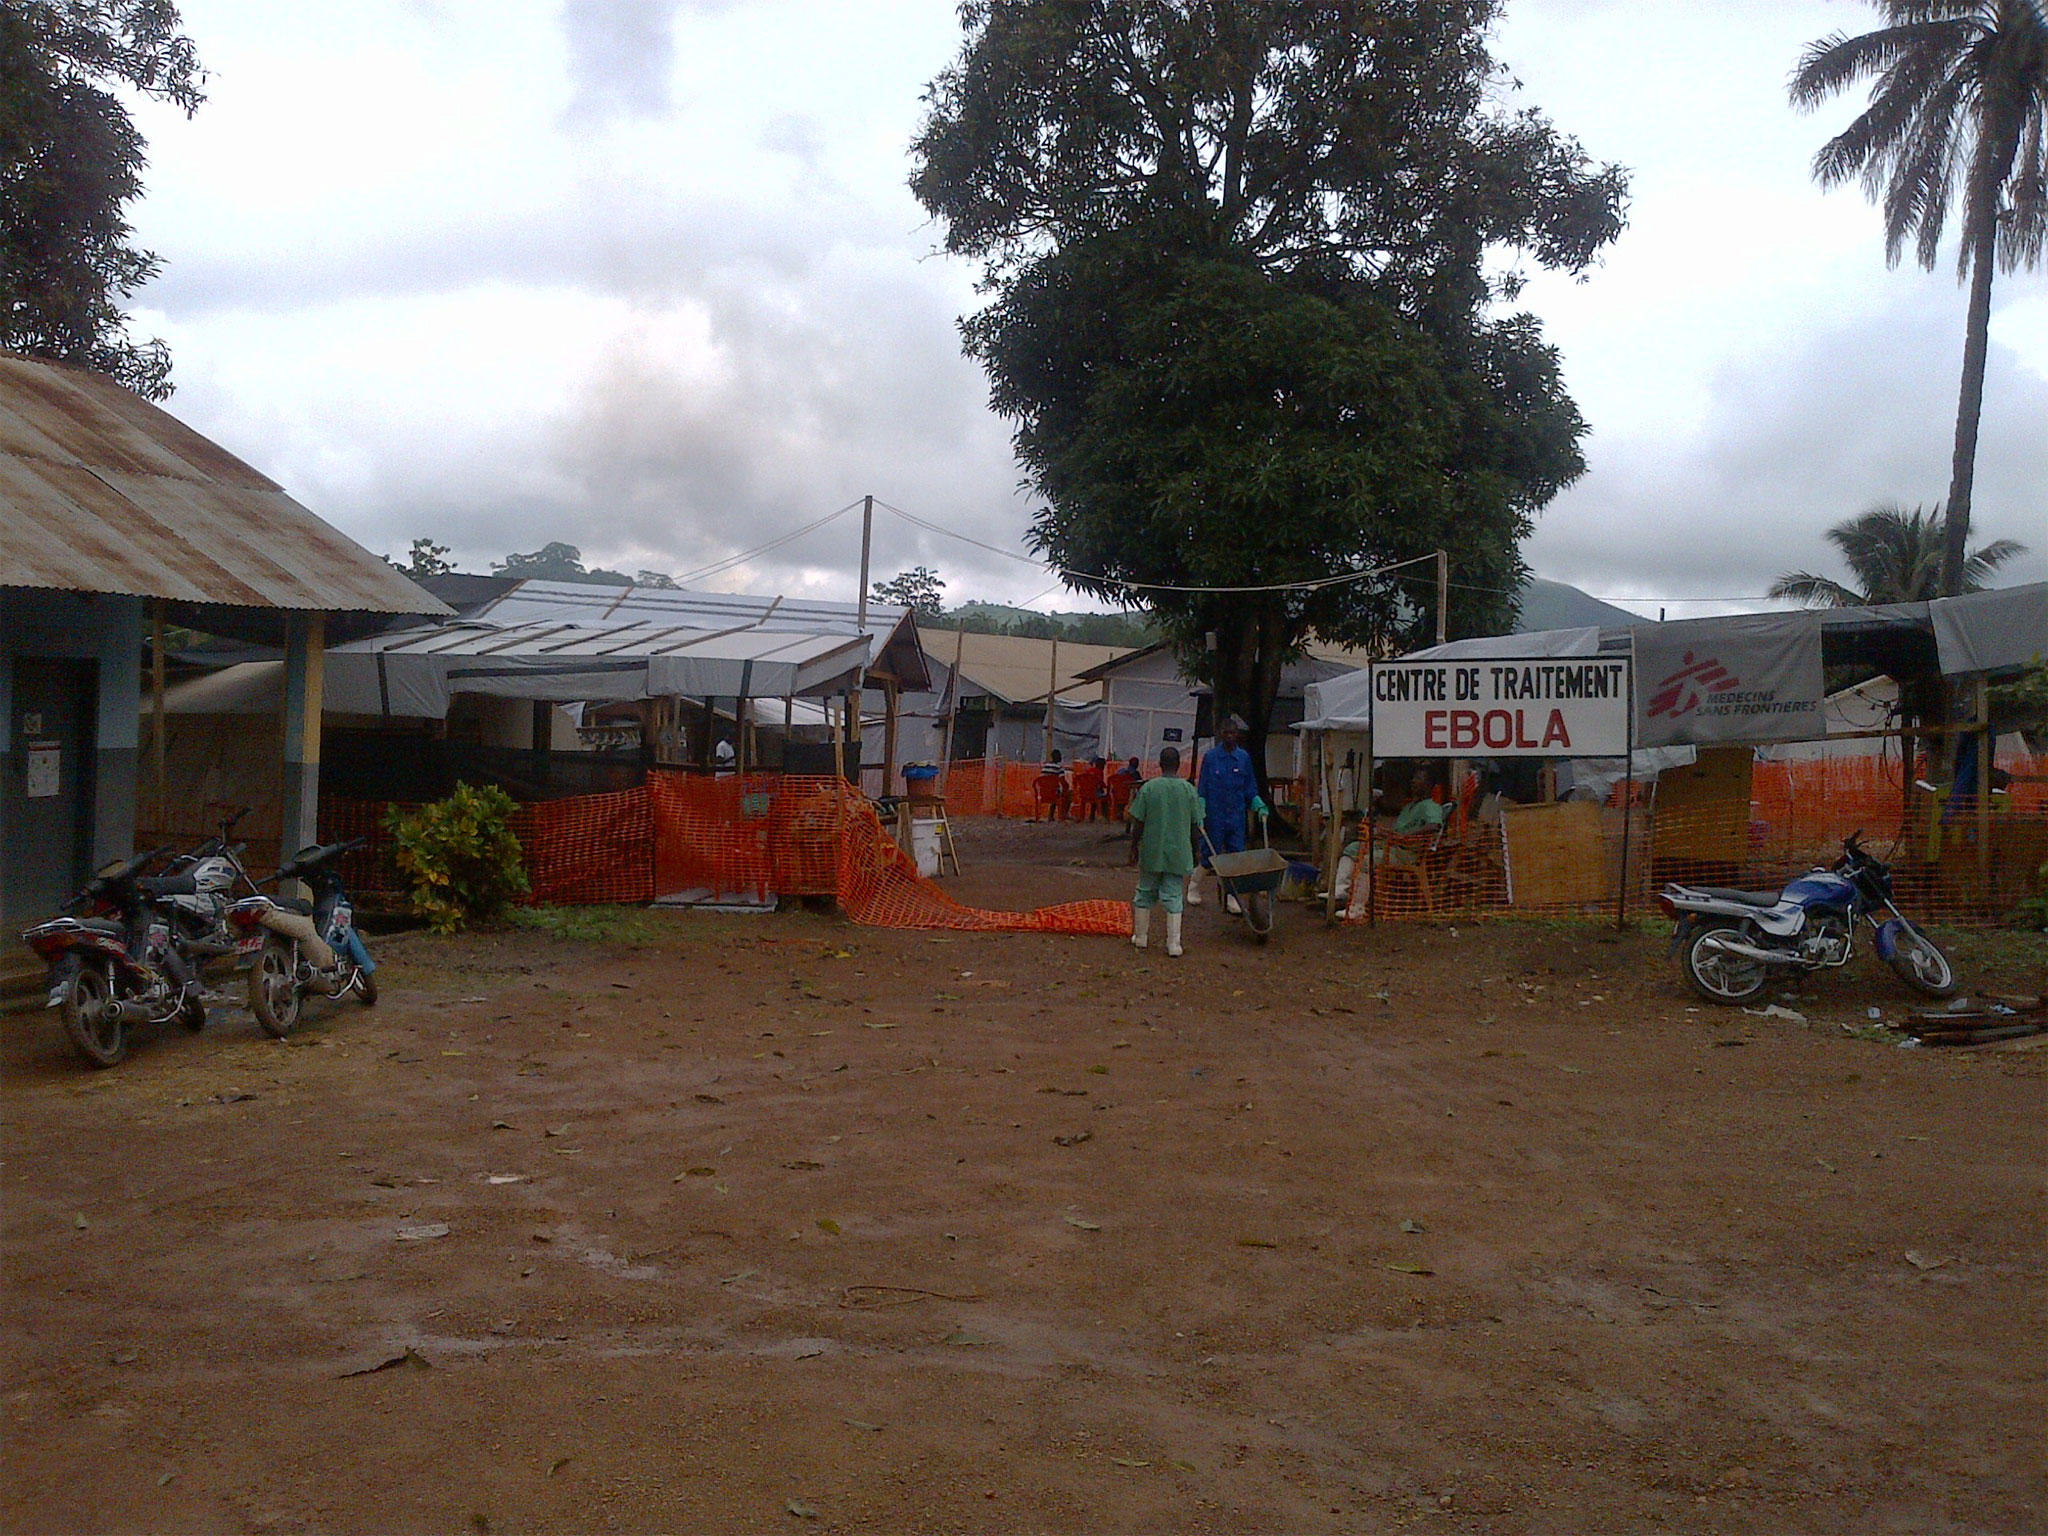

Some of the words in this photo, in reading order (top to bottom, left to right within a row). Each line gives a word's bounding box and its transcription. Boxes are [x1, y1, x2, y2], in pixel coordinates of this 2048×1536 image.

[1376, 669, 1446, 701] CENTRE
[1456, 667, 1480, 700] DE
[1490, 666, 1623, 699] TRAITEMENT
[1707, 690, 1776, 703] MEDECINS
[1424, 708, 1571, 749] EBOLA
